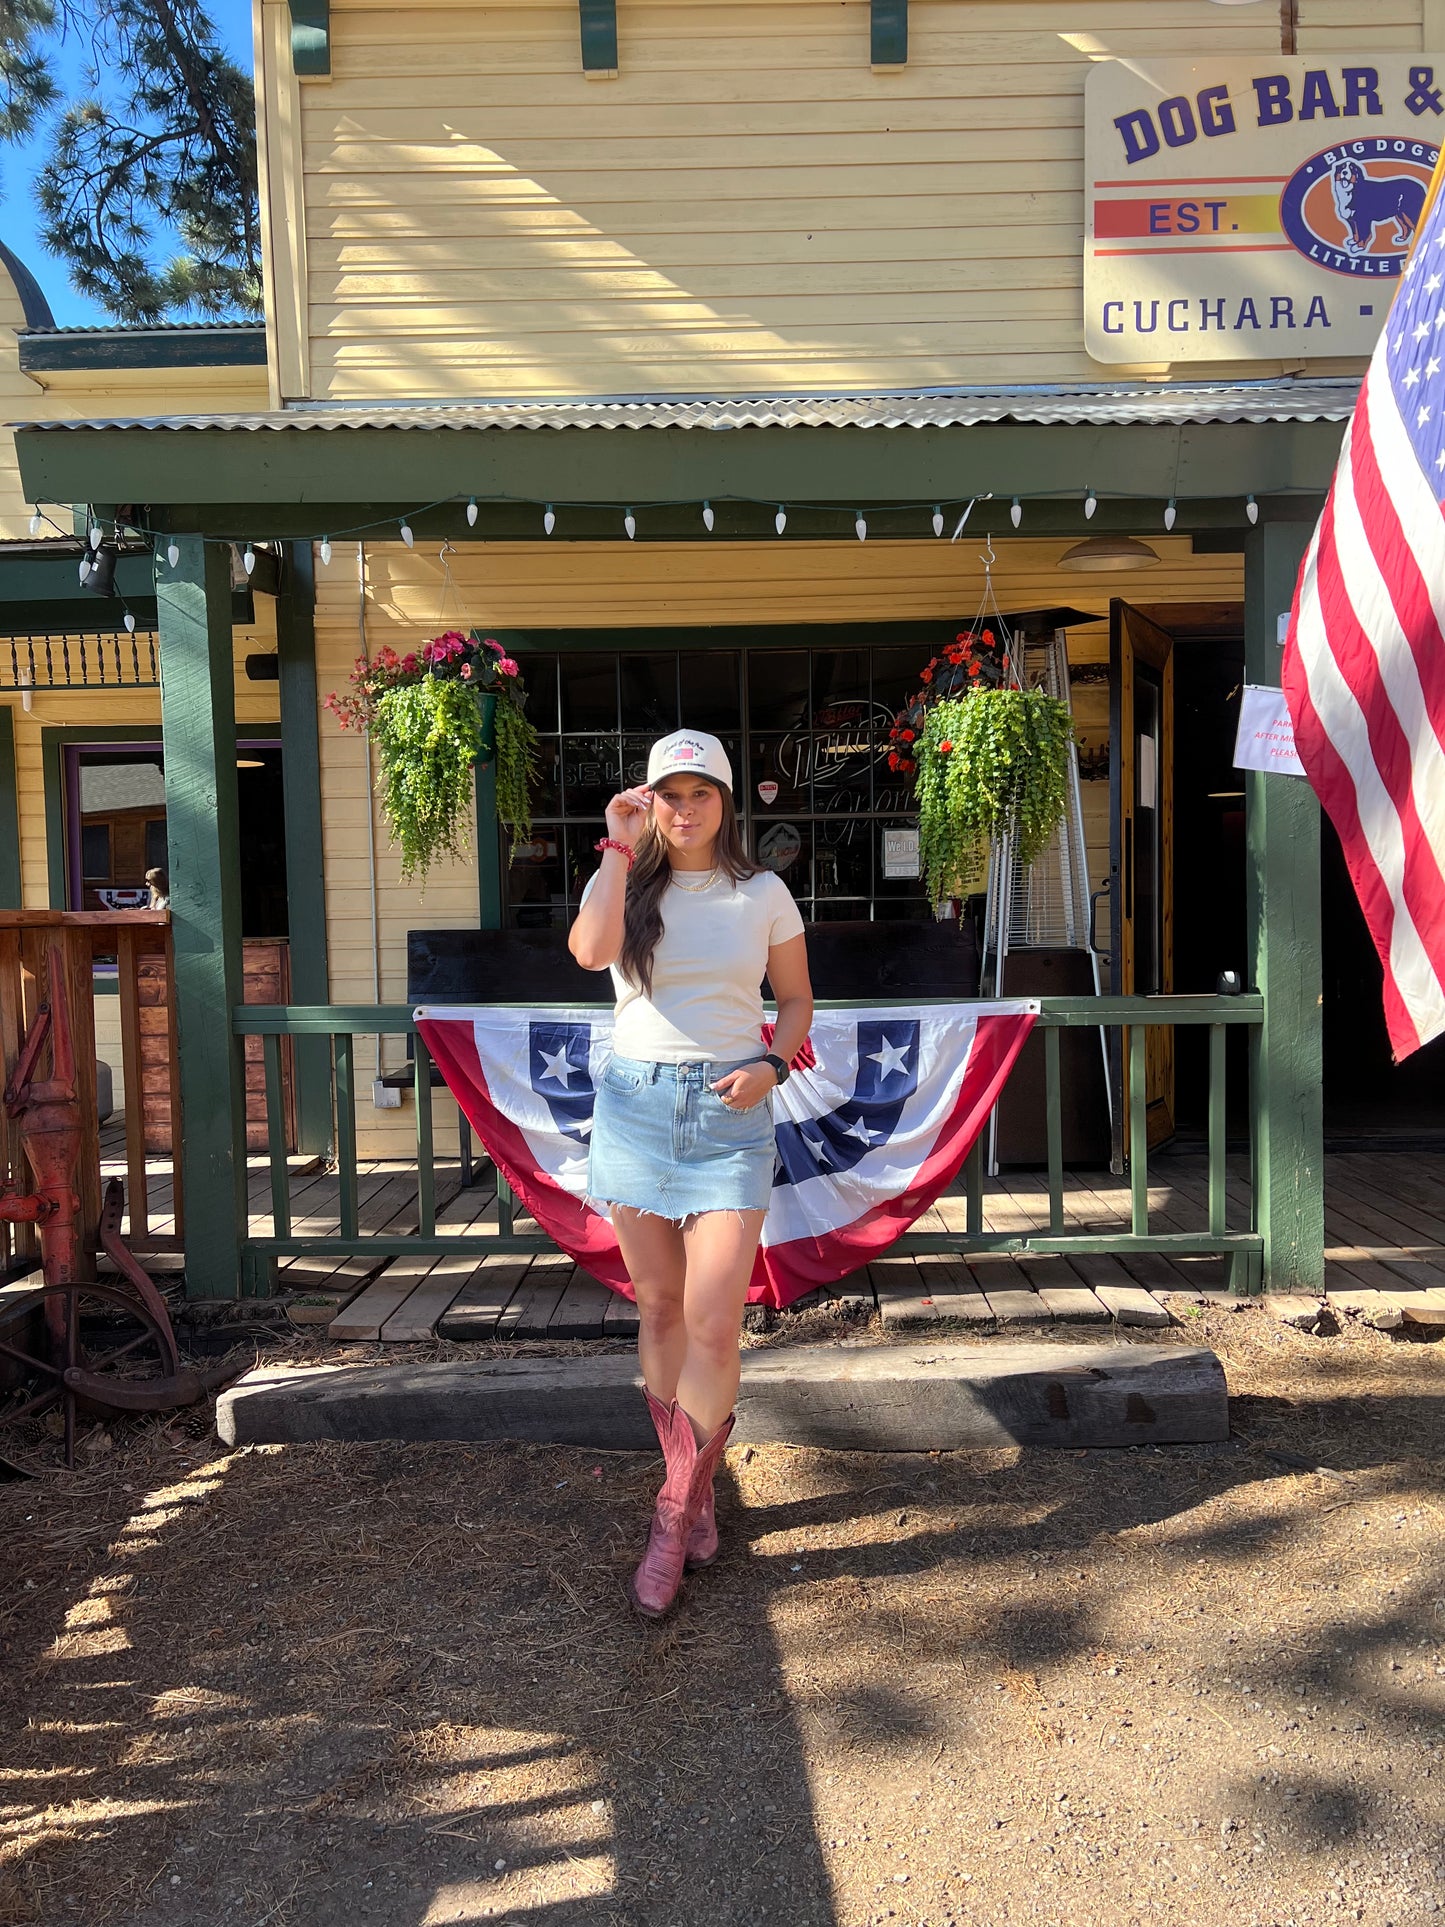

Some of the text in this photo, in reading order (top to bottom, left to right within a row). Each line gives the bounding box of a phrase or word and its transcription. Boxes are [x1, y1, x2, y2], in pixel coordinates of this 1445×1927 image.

[1113, 66, 1444, 165] DOG BAR &
[1324, 139, 1438, 166] BIG DOGS
[1149, 201, 1239, 234] EST.
[1308, 244, 1390, 273] LITTLE
[1102, 295, 1332, 334] CUCHARA
[1254, 732, 1279, 741] AFTER
[888, 840, 901, 852] We
